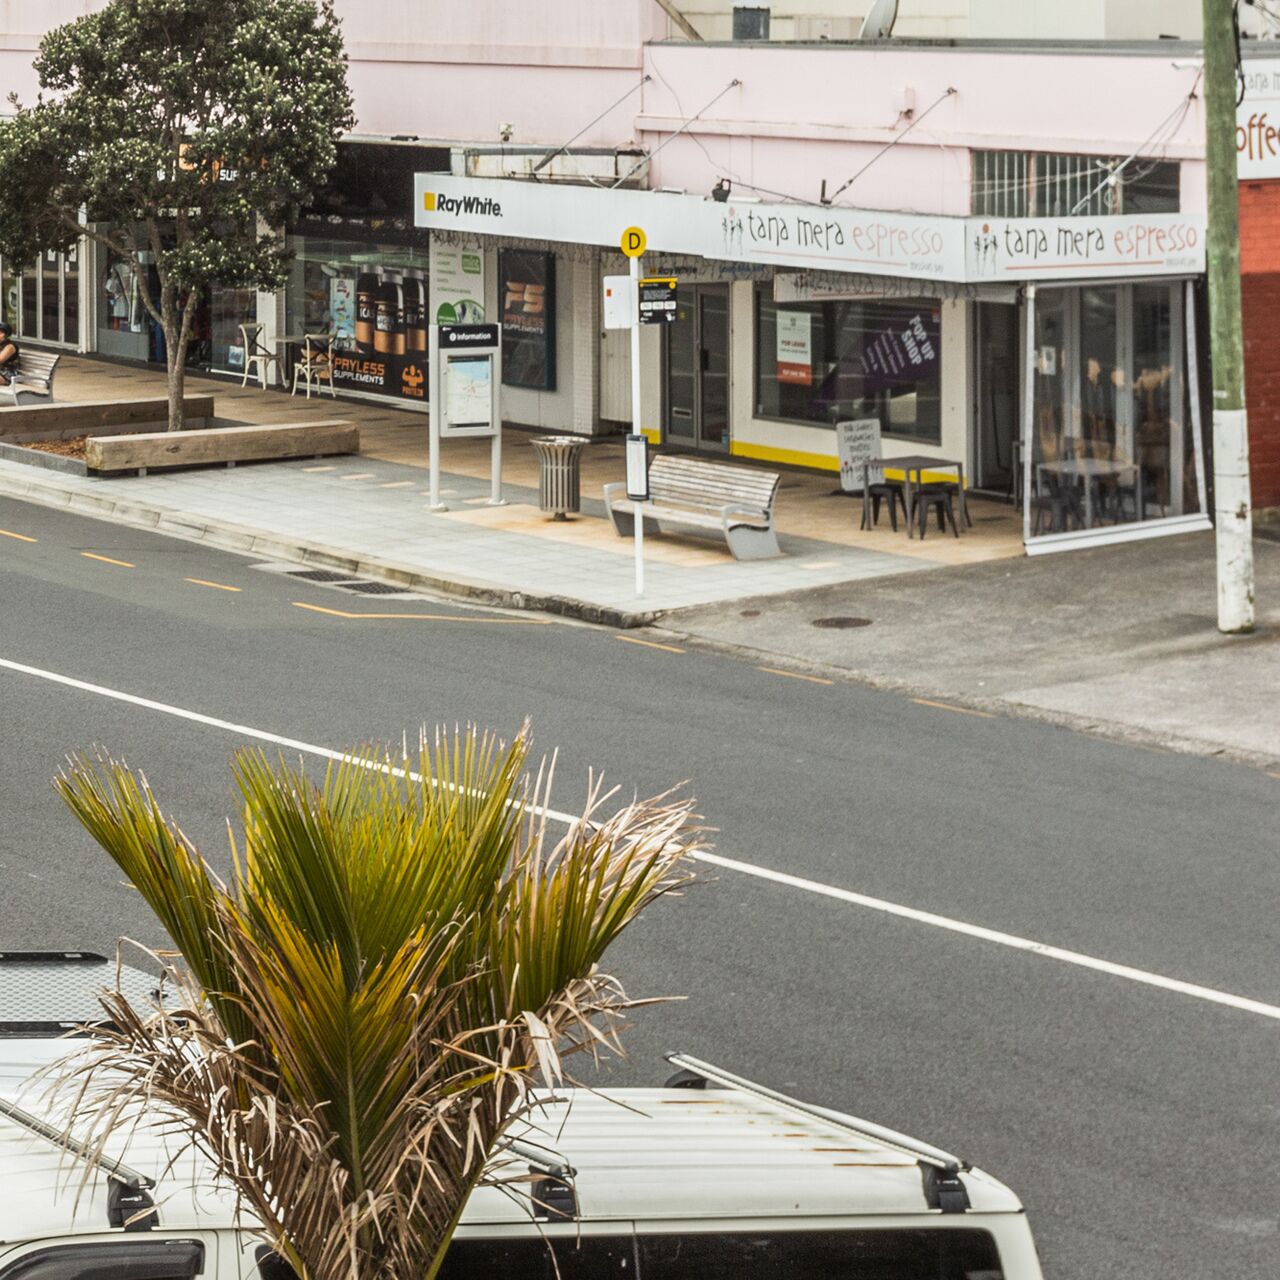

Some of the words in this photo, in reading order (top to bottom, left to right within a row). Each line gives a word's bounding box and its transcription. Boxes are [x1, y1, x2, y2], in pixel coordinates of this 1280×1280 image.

[1236, 113, 1280, 160] offe
[629, 232, 641, 250] D
[748, 209, 789, 248] tana
[797, 216, 844, 251] mera
[851, 222, 944, 258] espresso
[1004, 224, 1048, 260] tana
[1057, 224, 1105, 259] mera
[1113, 223, 1198, 259] espresso
[901, 329, 922, 365] SHOP
[909, 314, 927, 341] POP
[920, 341, 935, 360] UP
[333, 369, 384, 385] SUPPLEMENTS
[335, 357, 385, 376] PAYLESS
